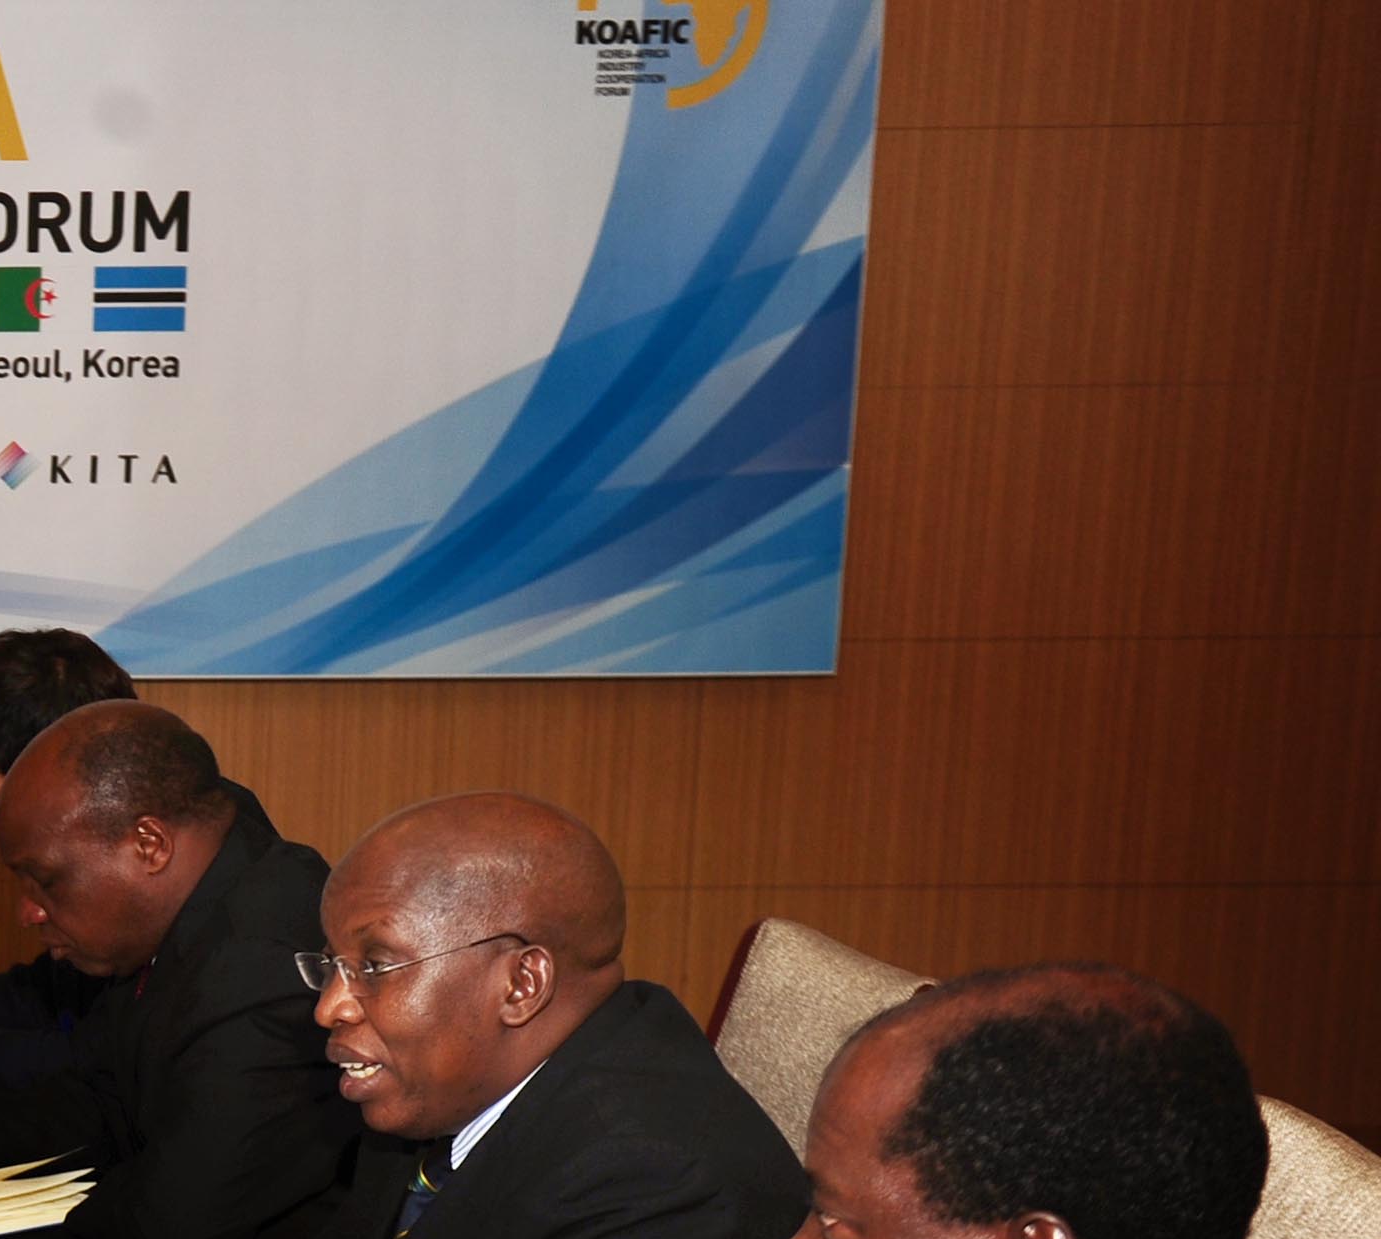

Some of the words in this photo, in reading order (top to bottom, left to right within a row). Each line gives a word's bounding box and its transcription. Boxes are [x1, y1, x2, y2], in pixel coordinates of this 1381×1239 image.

[576, 19, 691, 45] KOAFIC
[595, 87, 630, 96] FORUM
[82, 348, 181, 379] Korea
[49, 454, 178, 485] KITA
